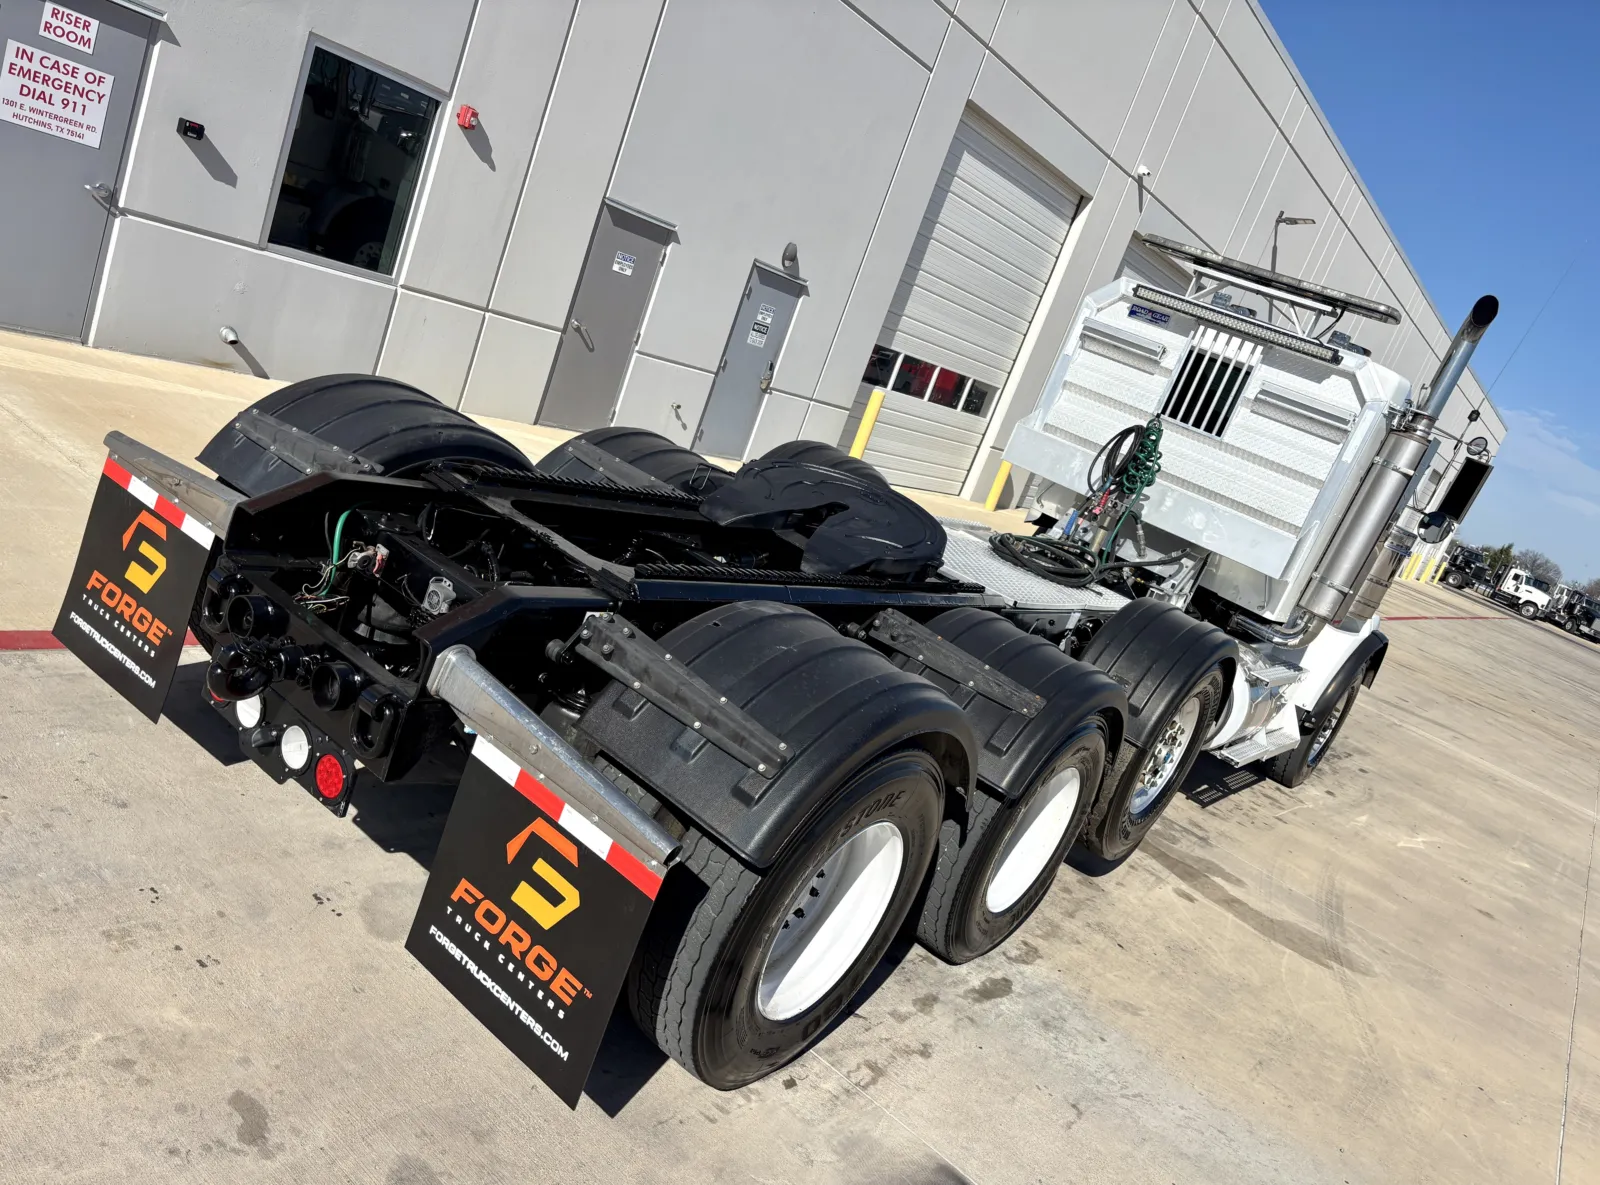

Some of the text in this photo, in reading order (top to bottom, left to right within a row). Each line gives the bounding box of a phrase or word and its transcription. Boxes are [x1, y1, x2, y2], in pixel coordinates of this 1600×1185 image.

[43, 20, 92, 50] ROOM
[50, 7, 92, 33] RISER
[8, 62, 106, 105] EMERGENCY
[15, 46, 106, 87] IN CASE OF
[2, 97, 98, 134] 1301 E. WINTERGREEN RD.
[19, 83, 87, 116] DIAL 911
[12, 112, 85, 140] HUTCHINS, TX 75141
[82, 593, 155, 658] TRUCK CENTERS
[86, 570, 168, 646] FORGE
[69, 611, 157, 689] FORGETRUCKCENTERS.COM
[446, 905, 566, 1020] TRUCK CENTERS
[450, 877, 583, 1006] FORGE
[429, 924, 569, 1062] FORGETRUCKCENTERS.COM
